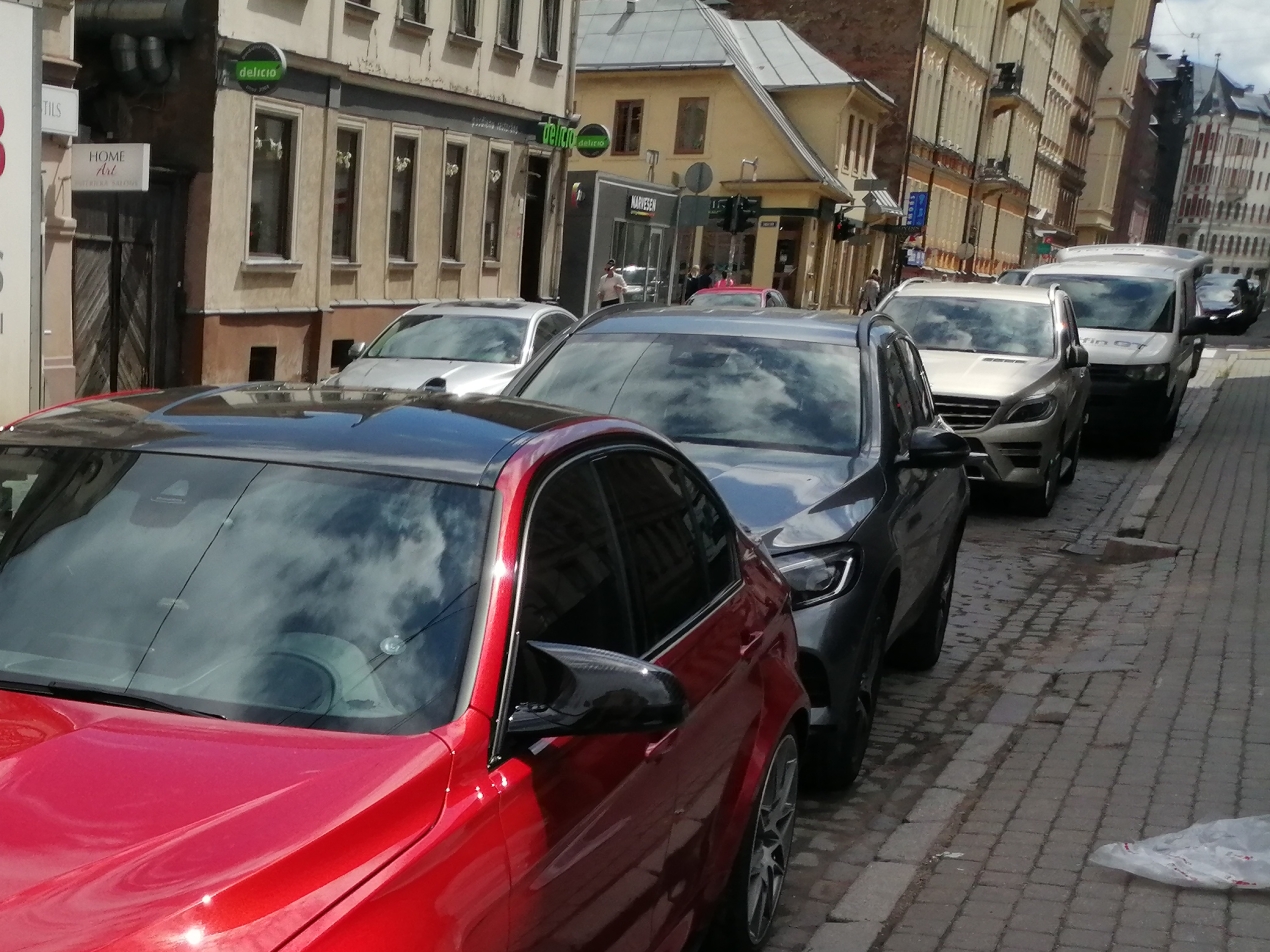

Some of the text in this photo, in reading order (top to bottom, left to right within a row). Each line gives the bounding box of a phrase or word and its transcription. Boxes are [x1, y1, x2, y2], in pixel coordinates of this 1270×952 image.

[89, 150, 125, 162] HOME
[96, 162, 117, 176] Art
[630, 194, 657, 212] NARVESEN
